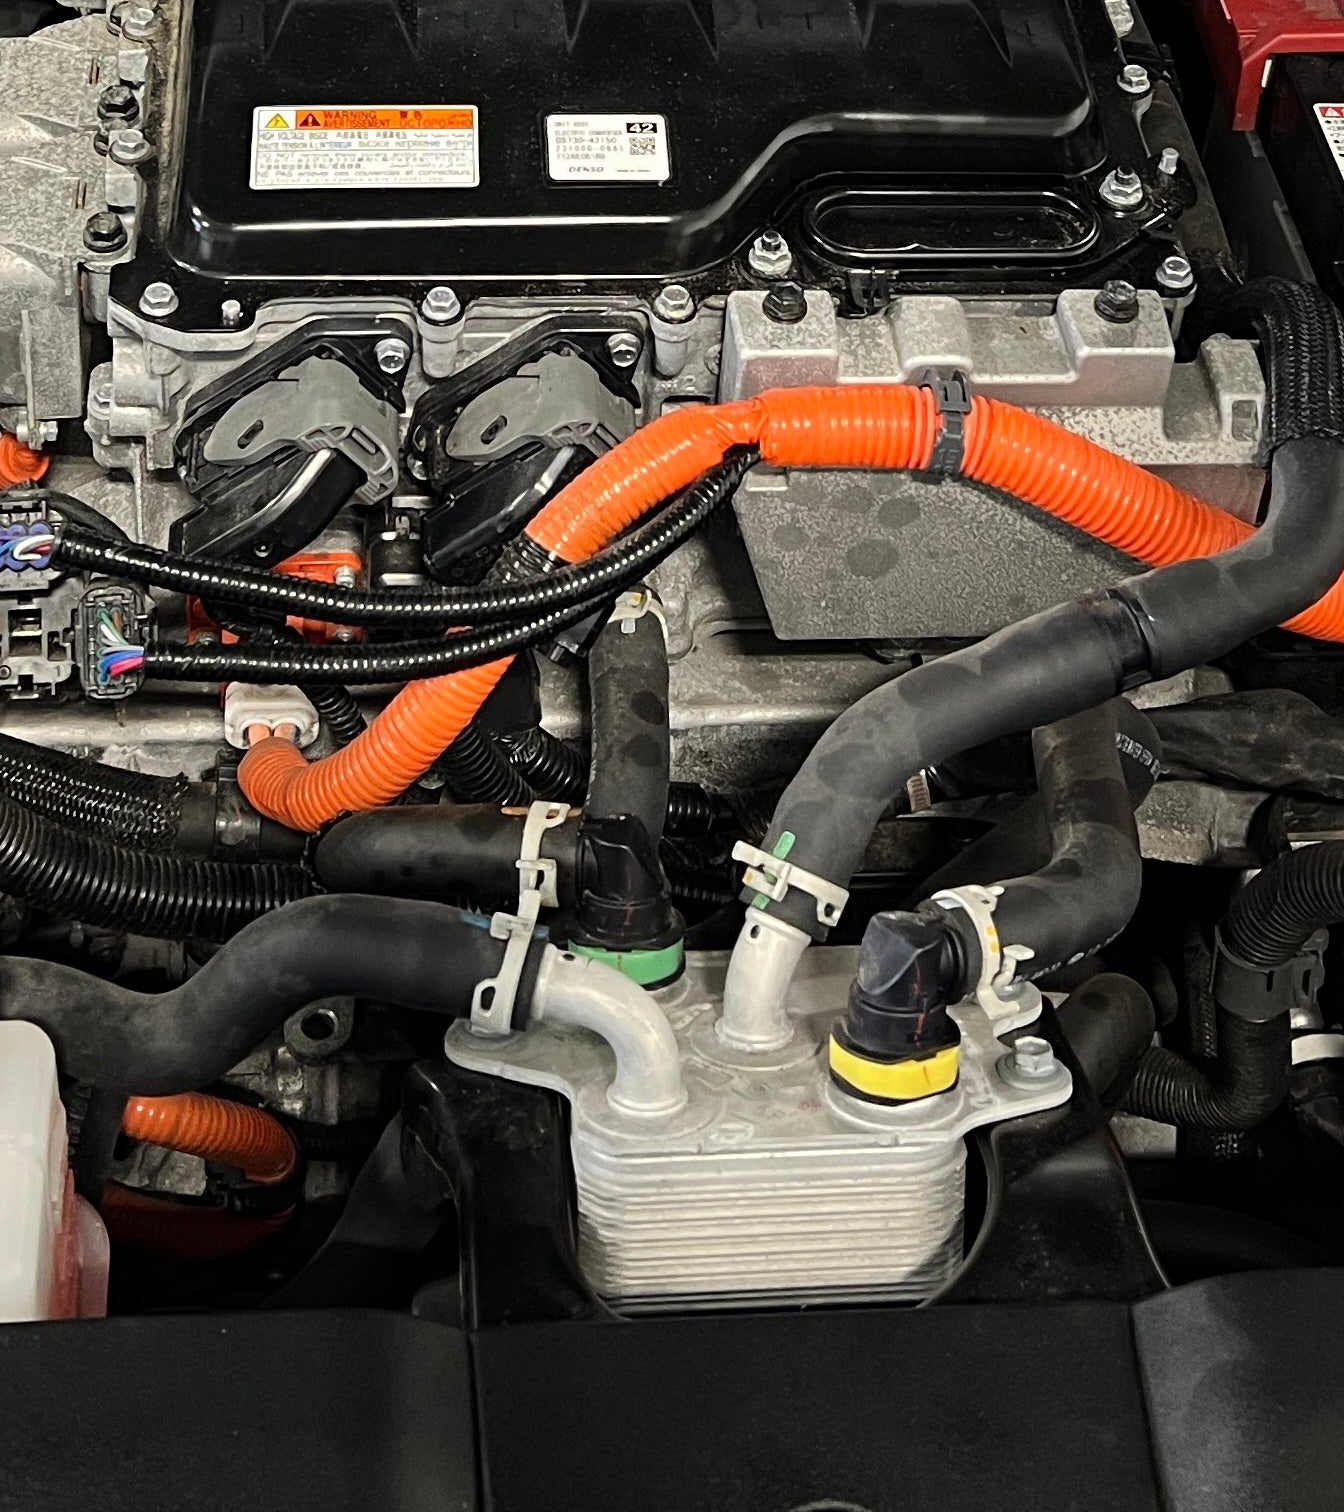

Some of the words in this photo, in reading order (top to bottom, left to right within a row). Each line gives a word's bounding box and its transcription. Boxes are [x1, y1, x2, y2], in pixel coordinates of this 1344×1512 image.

[324, 110, 377, 119] WARNING
[323, 119, 390, 128] AVERTISSEMENT
[629, 123, 655, 133] 42
